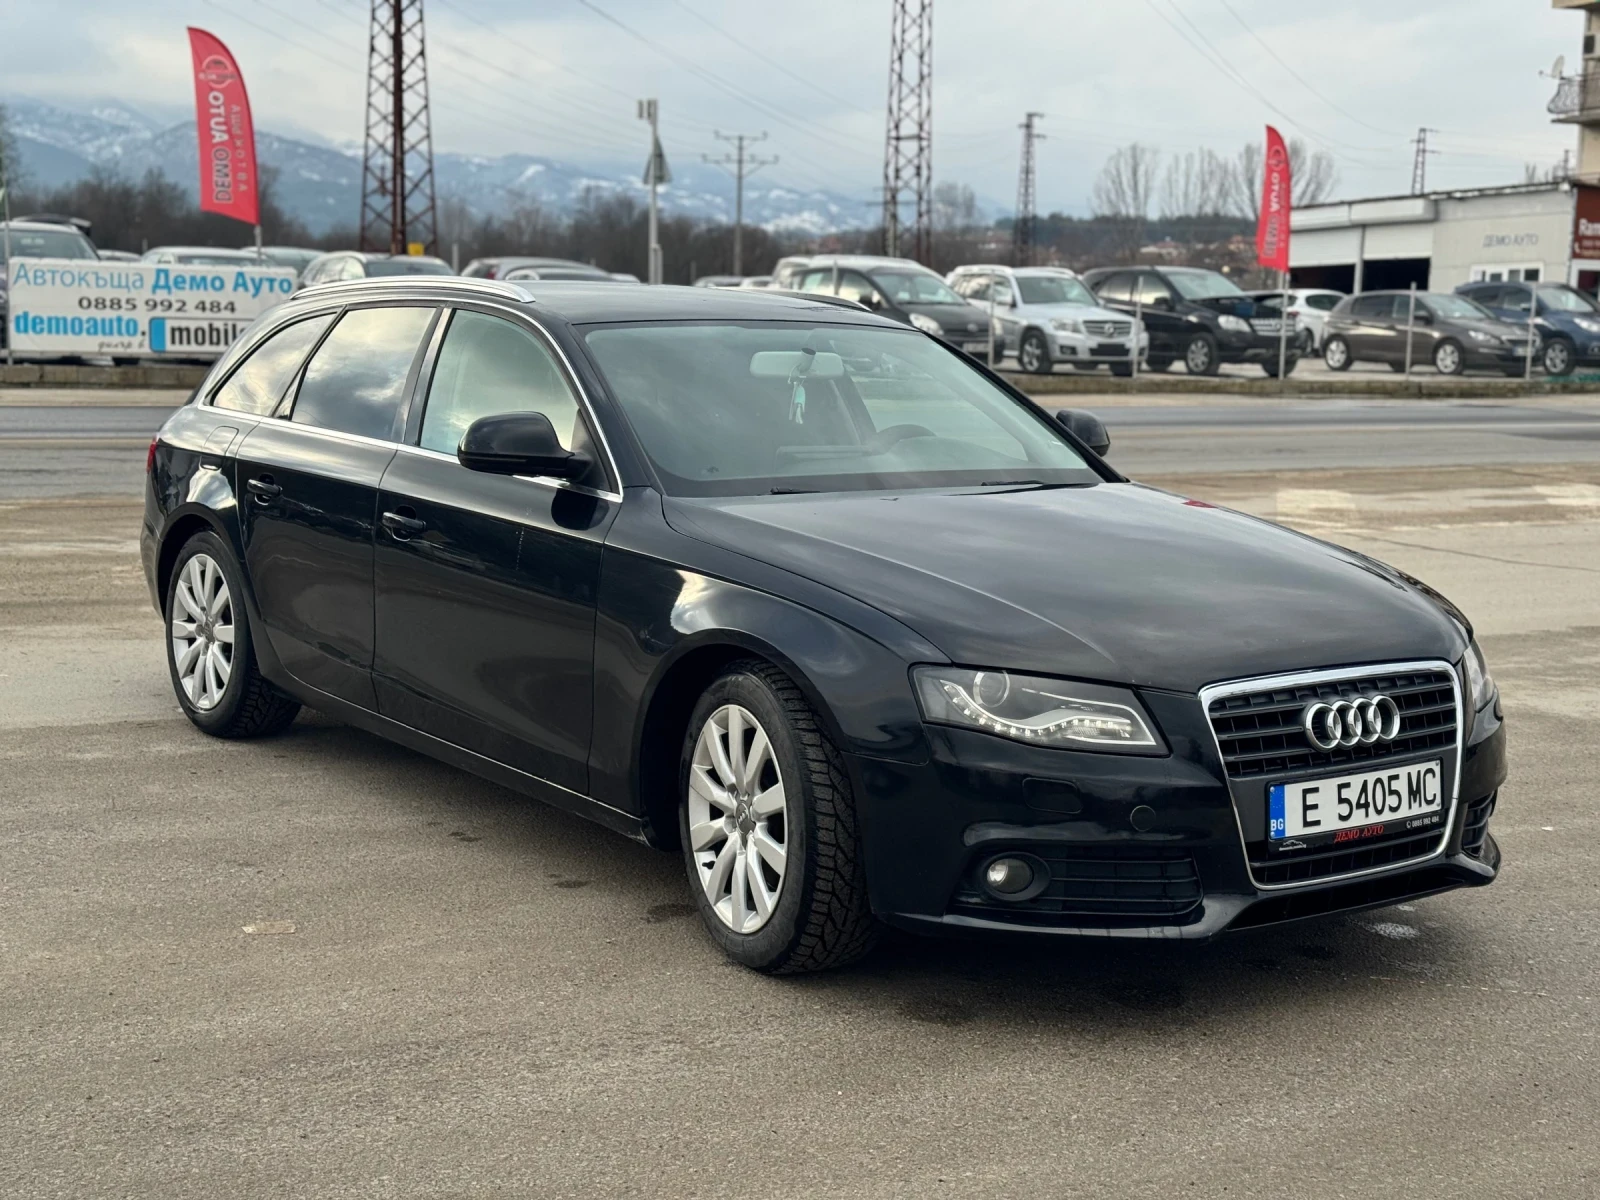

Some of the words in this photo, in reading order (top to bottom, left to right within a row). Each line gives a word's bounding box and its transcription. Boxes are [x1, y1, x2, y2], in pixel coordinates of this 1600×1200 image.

[13, 262, 145, 293] Автокъща
[151, 267, 226, 295] Демо
[232, 271, 293, 299] Ауто
[78, 296, 137, 311] 0885
[144, 298, 188, 313] 992
[194, 300, 237, 314] 484
[1302, 786, 1321, 828] E
[1337, 773, 1403, 822] 5405
[1407, 767, 1437, 810] MC
[1270, 818, 1284, 831] BG
[1334, 828, 1359, 844] ДЕМО
[1361, 824, 1385, 838] АУТО
